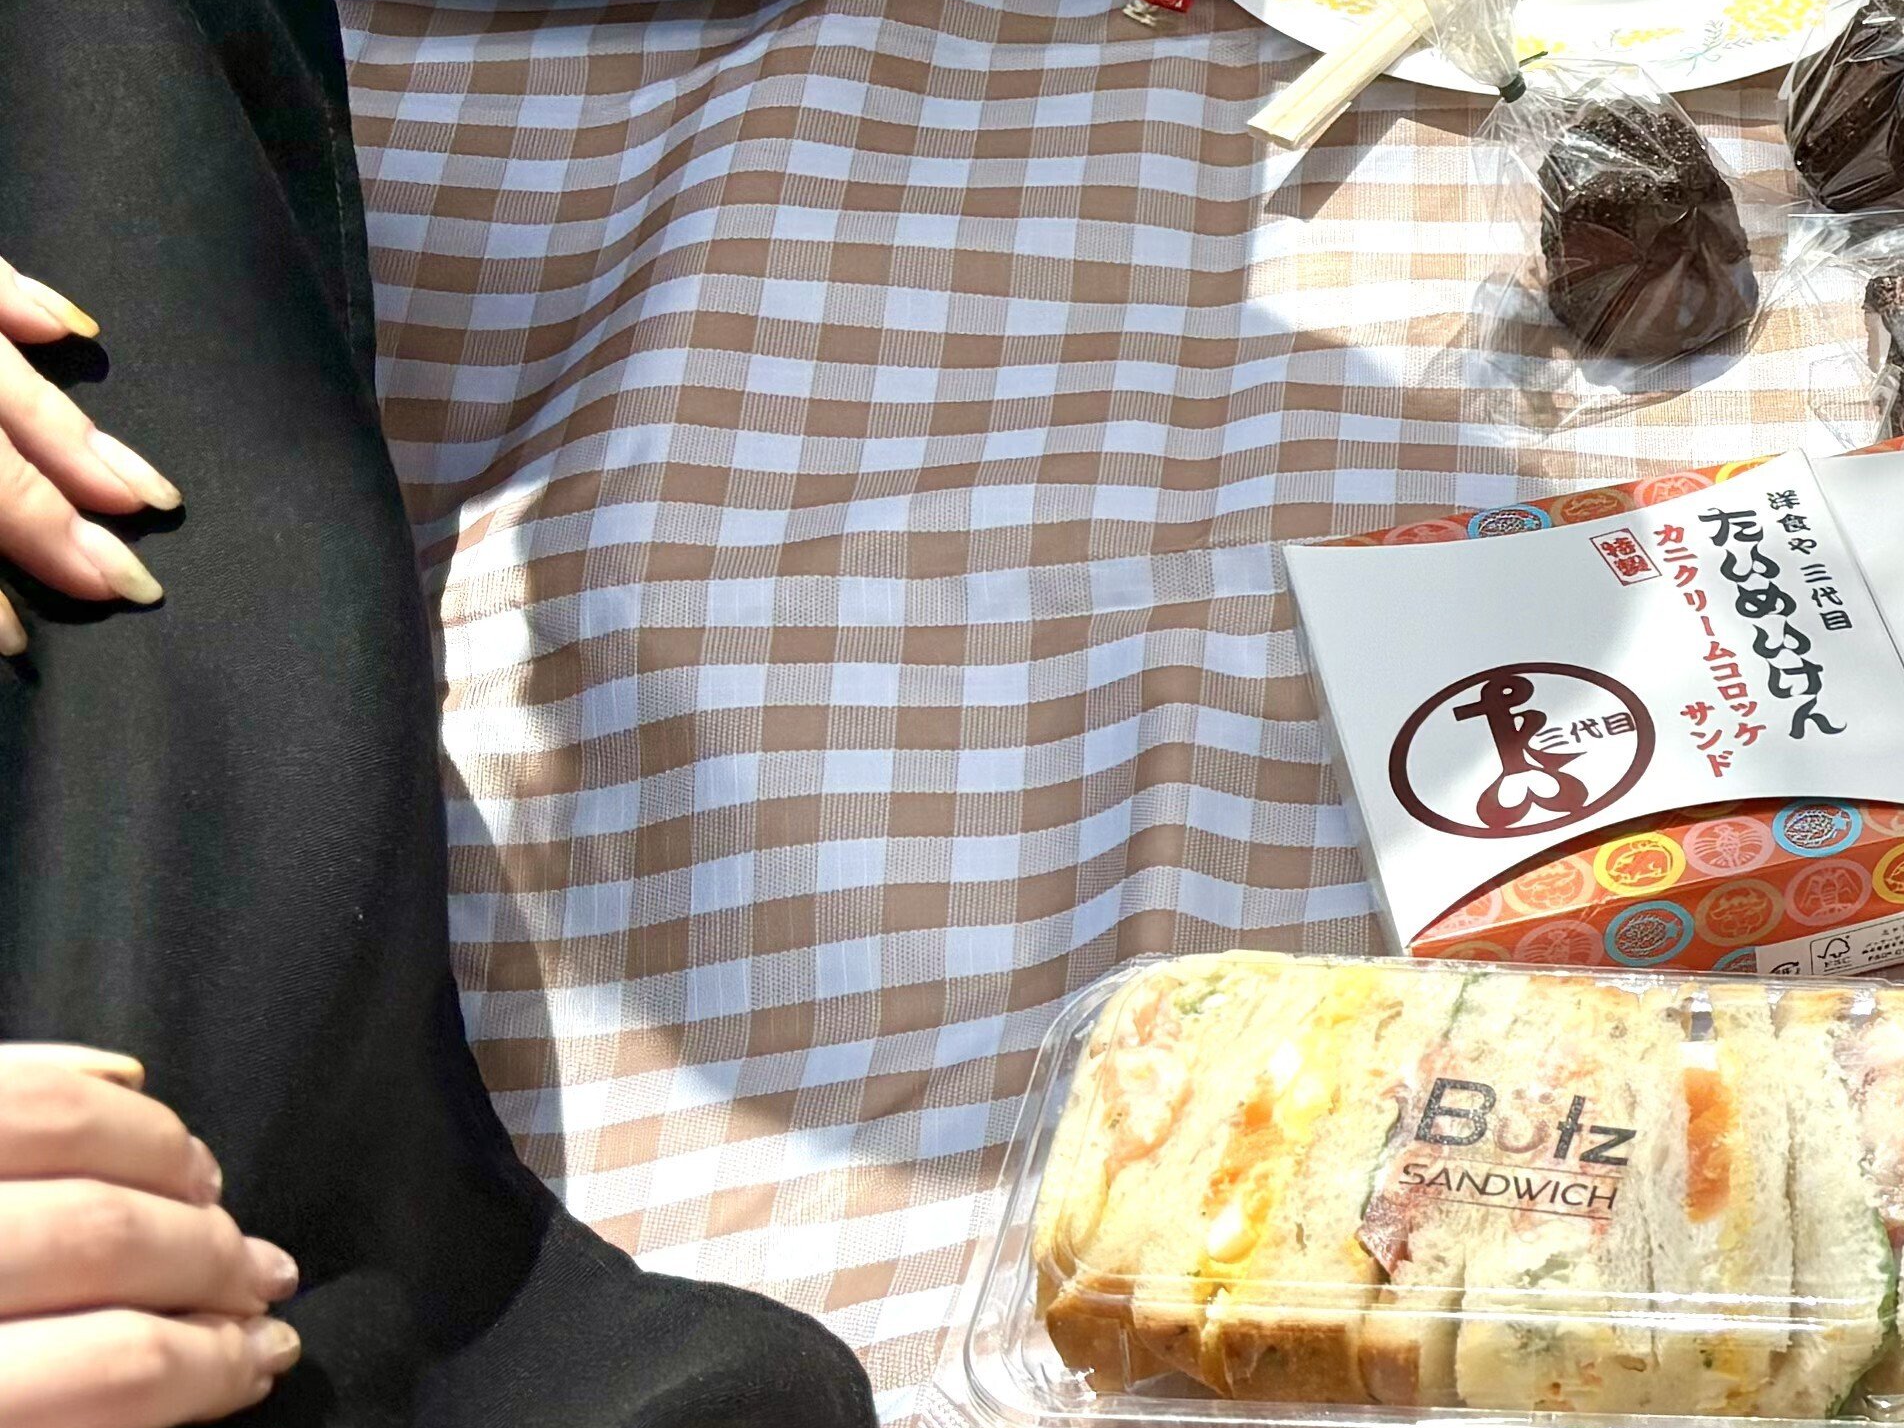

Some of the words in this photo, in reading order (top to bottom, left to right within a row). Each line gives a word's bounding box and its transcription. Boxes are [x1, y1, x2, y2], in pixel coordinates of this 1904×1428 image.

[1599, 535, 1653, 577] 特製
[1766, 489, 1817, 555] 洋食や
[1800, 562, 1853, 632] 三代目
[1653, 523, 1768, 747] カニクリームコロッケ
[1697, 508, 1848, 740] たいめいけん
[1538, 710, 1638, 755] 三代目
[1680, 700, 1735, 779] サンド
[1397, 1162, 1619, 1212] SANDWICH
